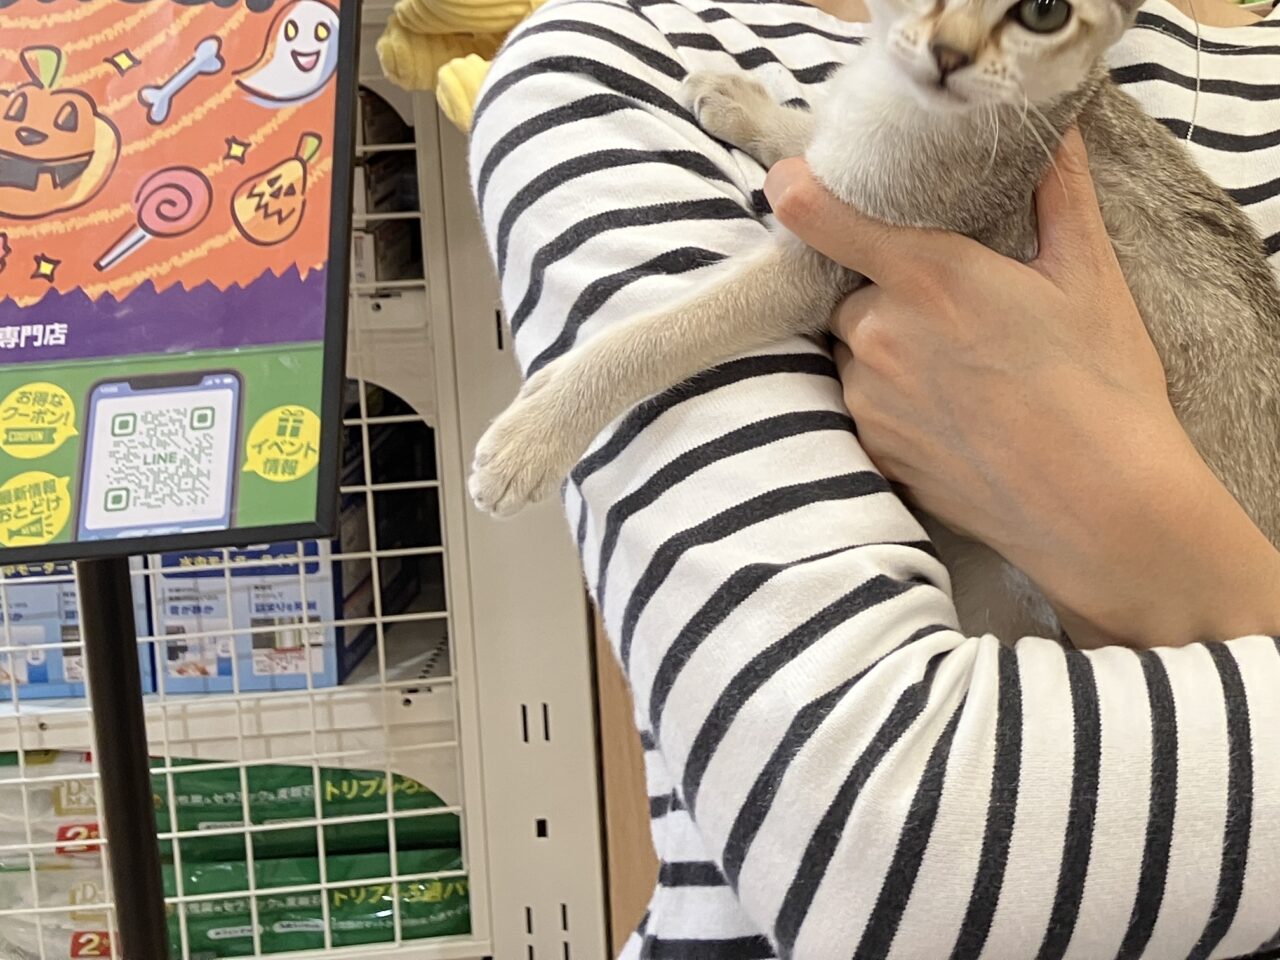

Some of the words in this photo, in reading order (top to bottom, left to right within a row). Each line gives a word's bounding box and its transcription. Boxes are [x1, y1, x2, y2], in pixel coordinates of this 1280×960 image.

[0, 322, 68, 349] 専門店
[16, 391, 66, 407] お得な
[251, 438, 318, 458] イベント
[142, 451, 178, 466] LINE
